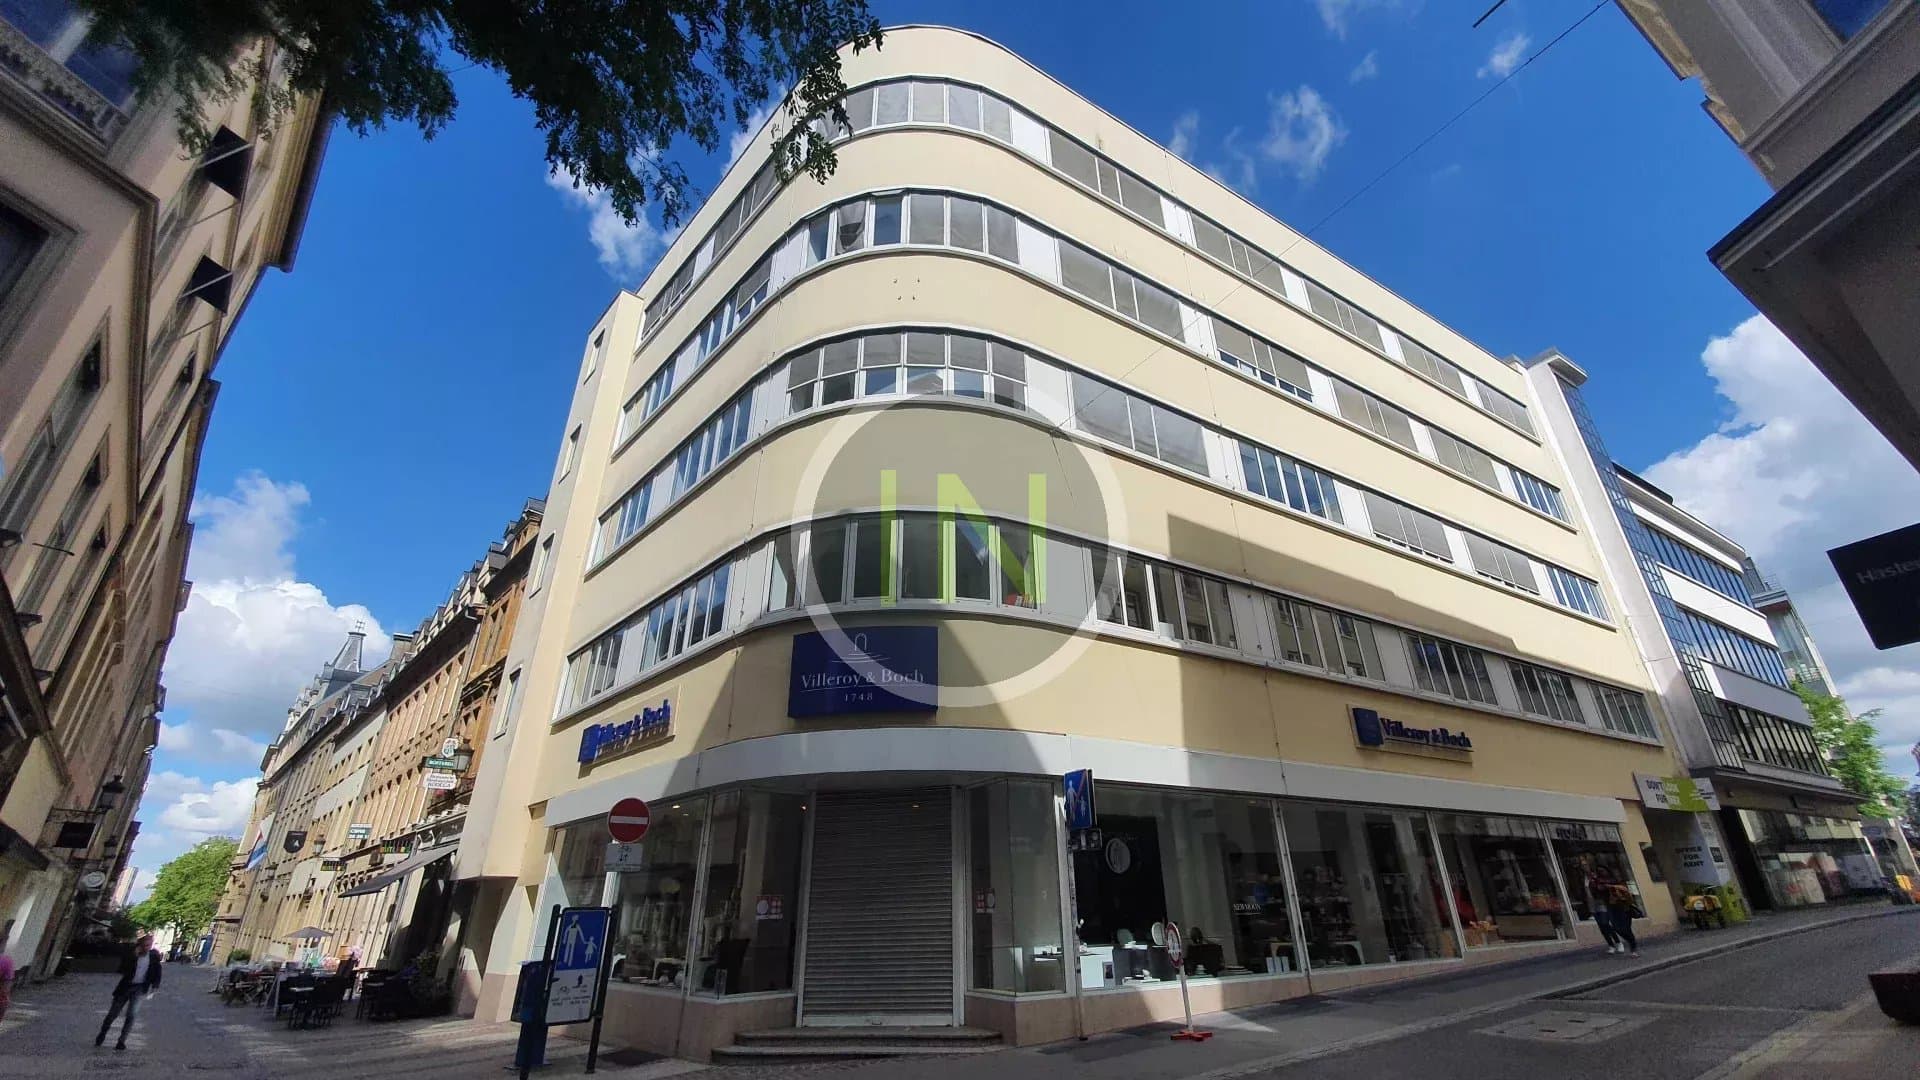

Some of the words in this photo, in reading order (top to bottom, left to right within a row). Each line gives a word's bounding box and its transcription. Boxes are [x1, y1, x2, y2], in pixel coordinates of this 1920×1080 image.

[800, 671, 862, 689] Villeroy
[865, 671, 874, 683] &
[881, 668, 925, 684] Boch
[844, 692, 873, 702] 1748
[1380, 717, 1430, 744] Villeroy
[1440, 727, 1472, 748] Boch
